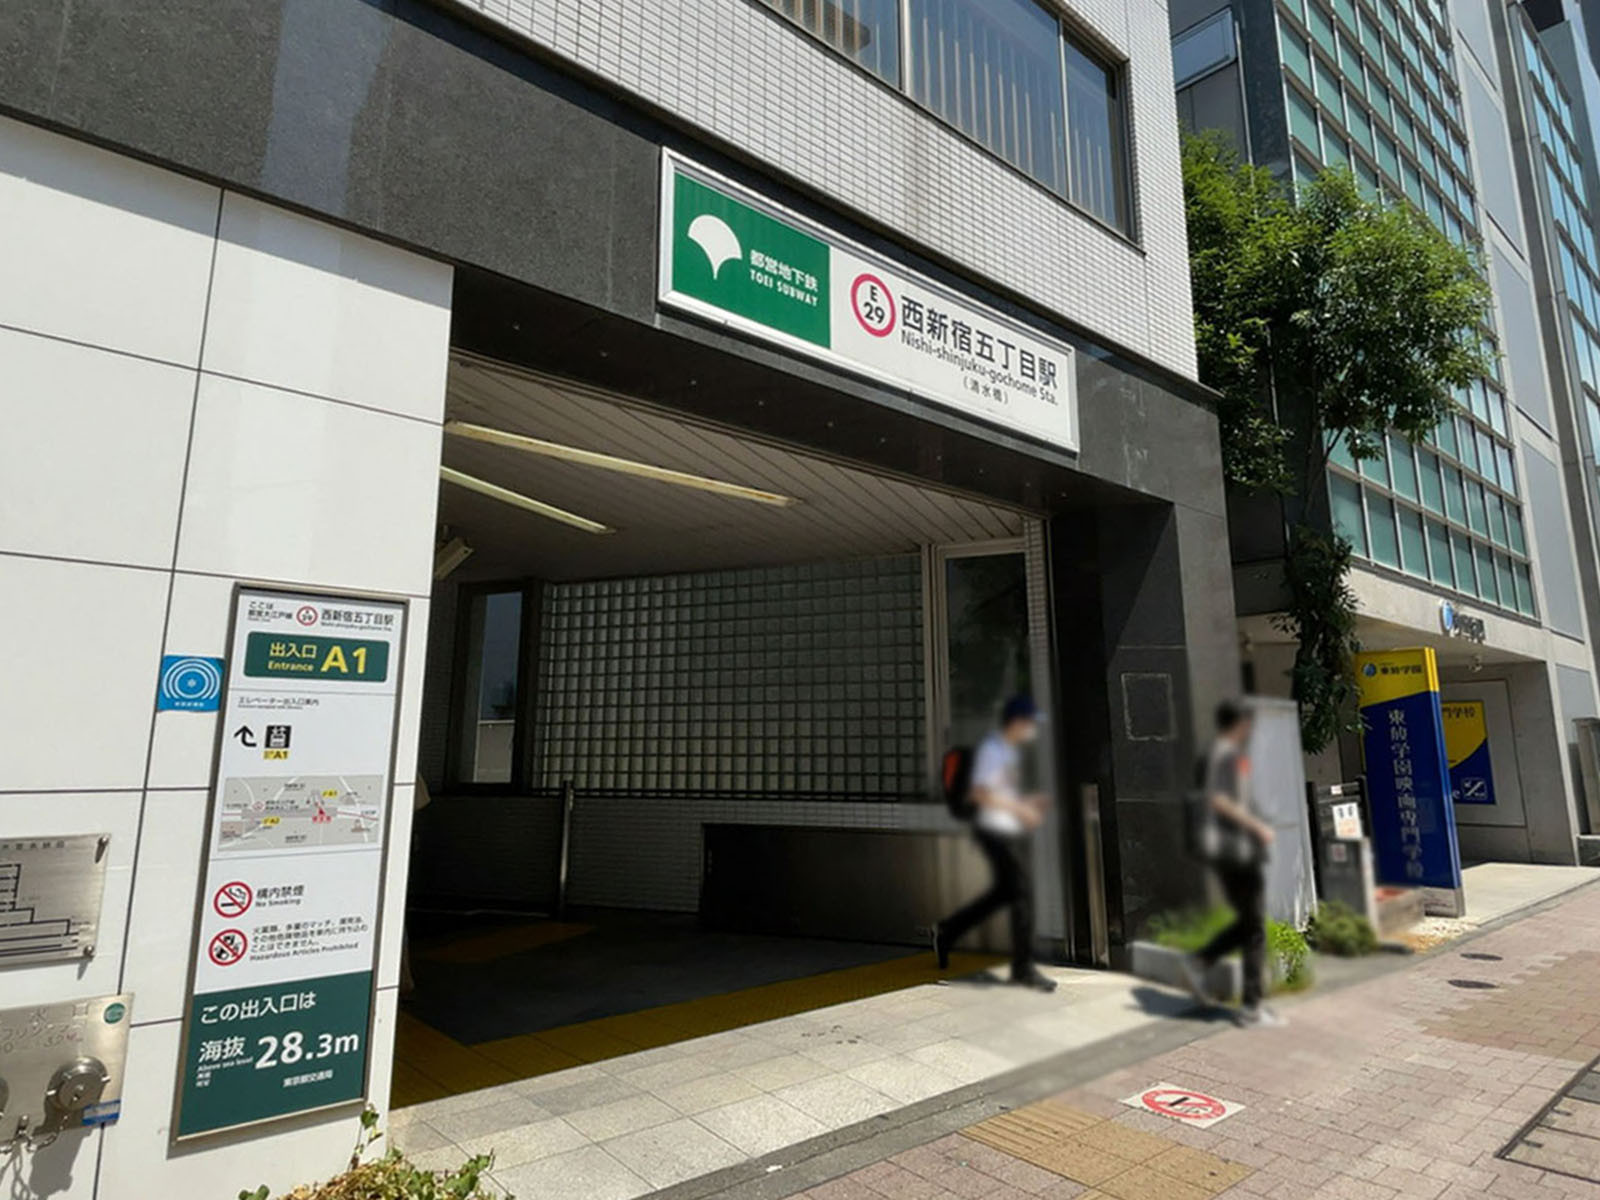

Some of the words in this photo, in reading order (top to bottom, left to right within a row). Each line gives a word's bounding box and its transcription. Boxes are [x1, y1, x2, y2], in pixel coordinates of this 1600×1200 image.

[750, 249, 819, 292] 都営地下鉄
[750, 268, 773, 288] TOEI
[777, 281, 818, 307] SUBWAY
[869, 285, 878, 302] E
[863, 302, 885, 324] 29
[901, 294, 1058, 390] 西新宿五丁目駅
[901, 329, 1037, 398] Nishi-shinjuku-gochome
[1039, 385, 1059, 406] Sta.
[321, 608, 394, 626] 西新宿五丁目駅
[267, 660, 314, 672] Entrance
[269, 642, 318, 659] 出入口
[320, 645, 367, 674] A1
[255, 900, 267, 908] No
[268, 899, 301, 907] Smoking
[256, 884, 304, 898] 構内禁煙
[201, 991, 317, 1024] この出入口は
[198, 1036, 245, 1063] 海抜
[255, 1031, 359, 1069] 28.3m
